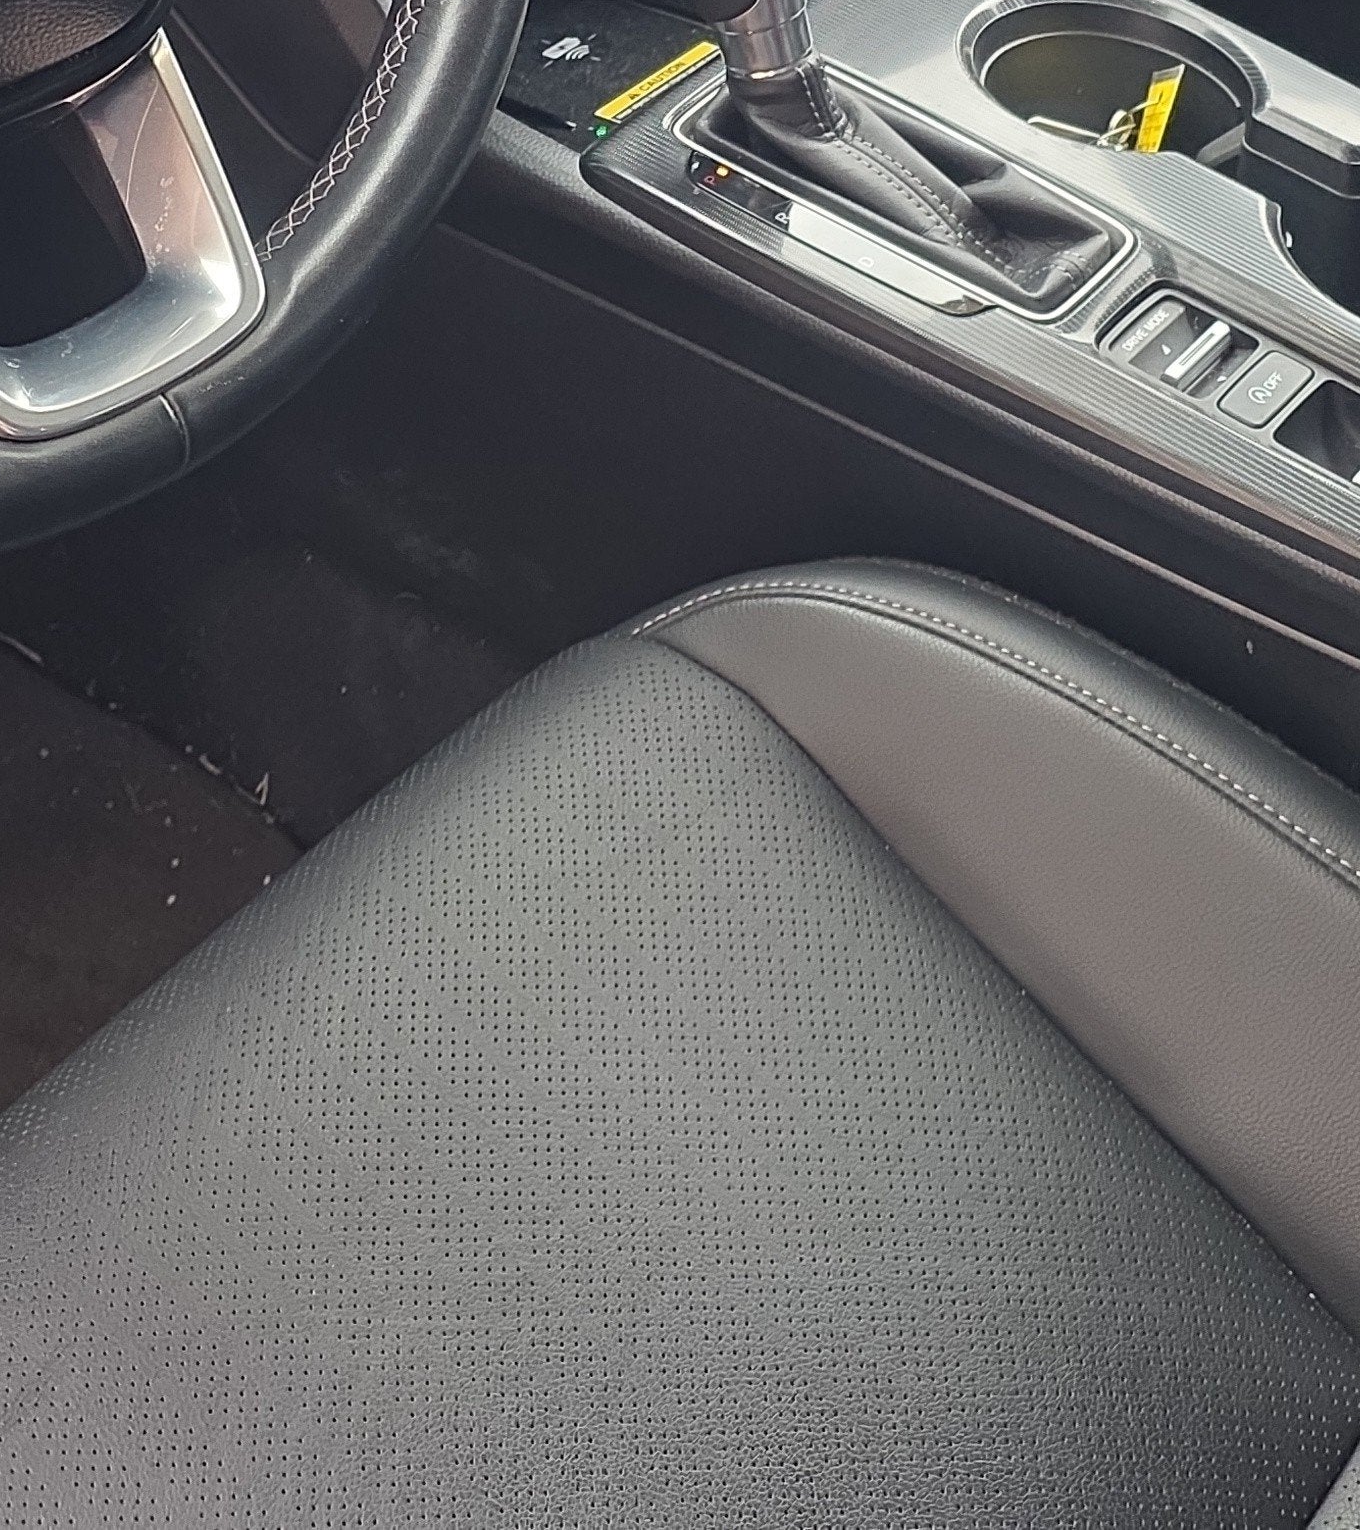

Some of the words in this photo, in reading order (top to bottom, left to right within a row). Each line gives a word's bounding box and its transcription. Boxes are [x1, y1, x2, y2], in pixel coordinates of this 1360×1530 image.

[704, 174, 715, 185] P
[774, 211, 790, 225] R
[1121, 328, 1148, 352] DRIVE
[1145, 308, 1170, 335] MODE
